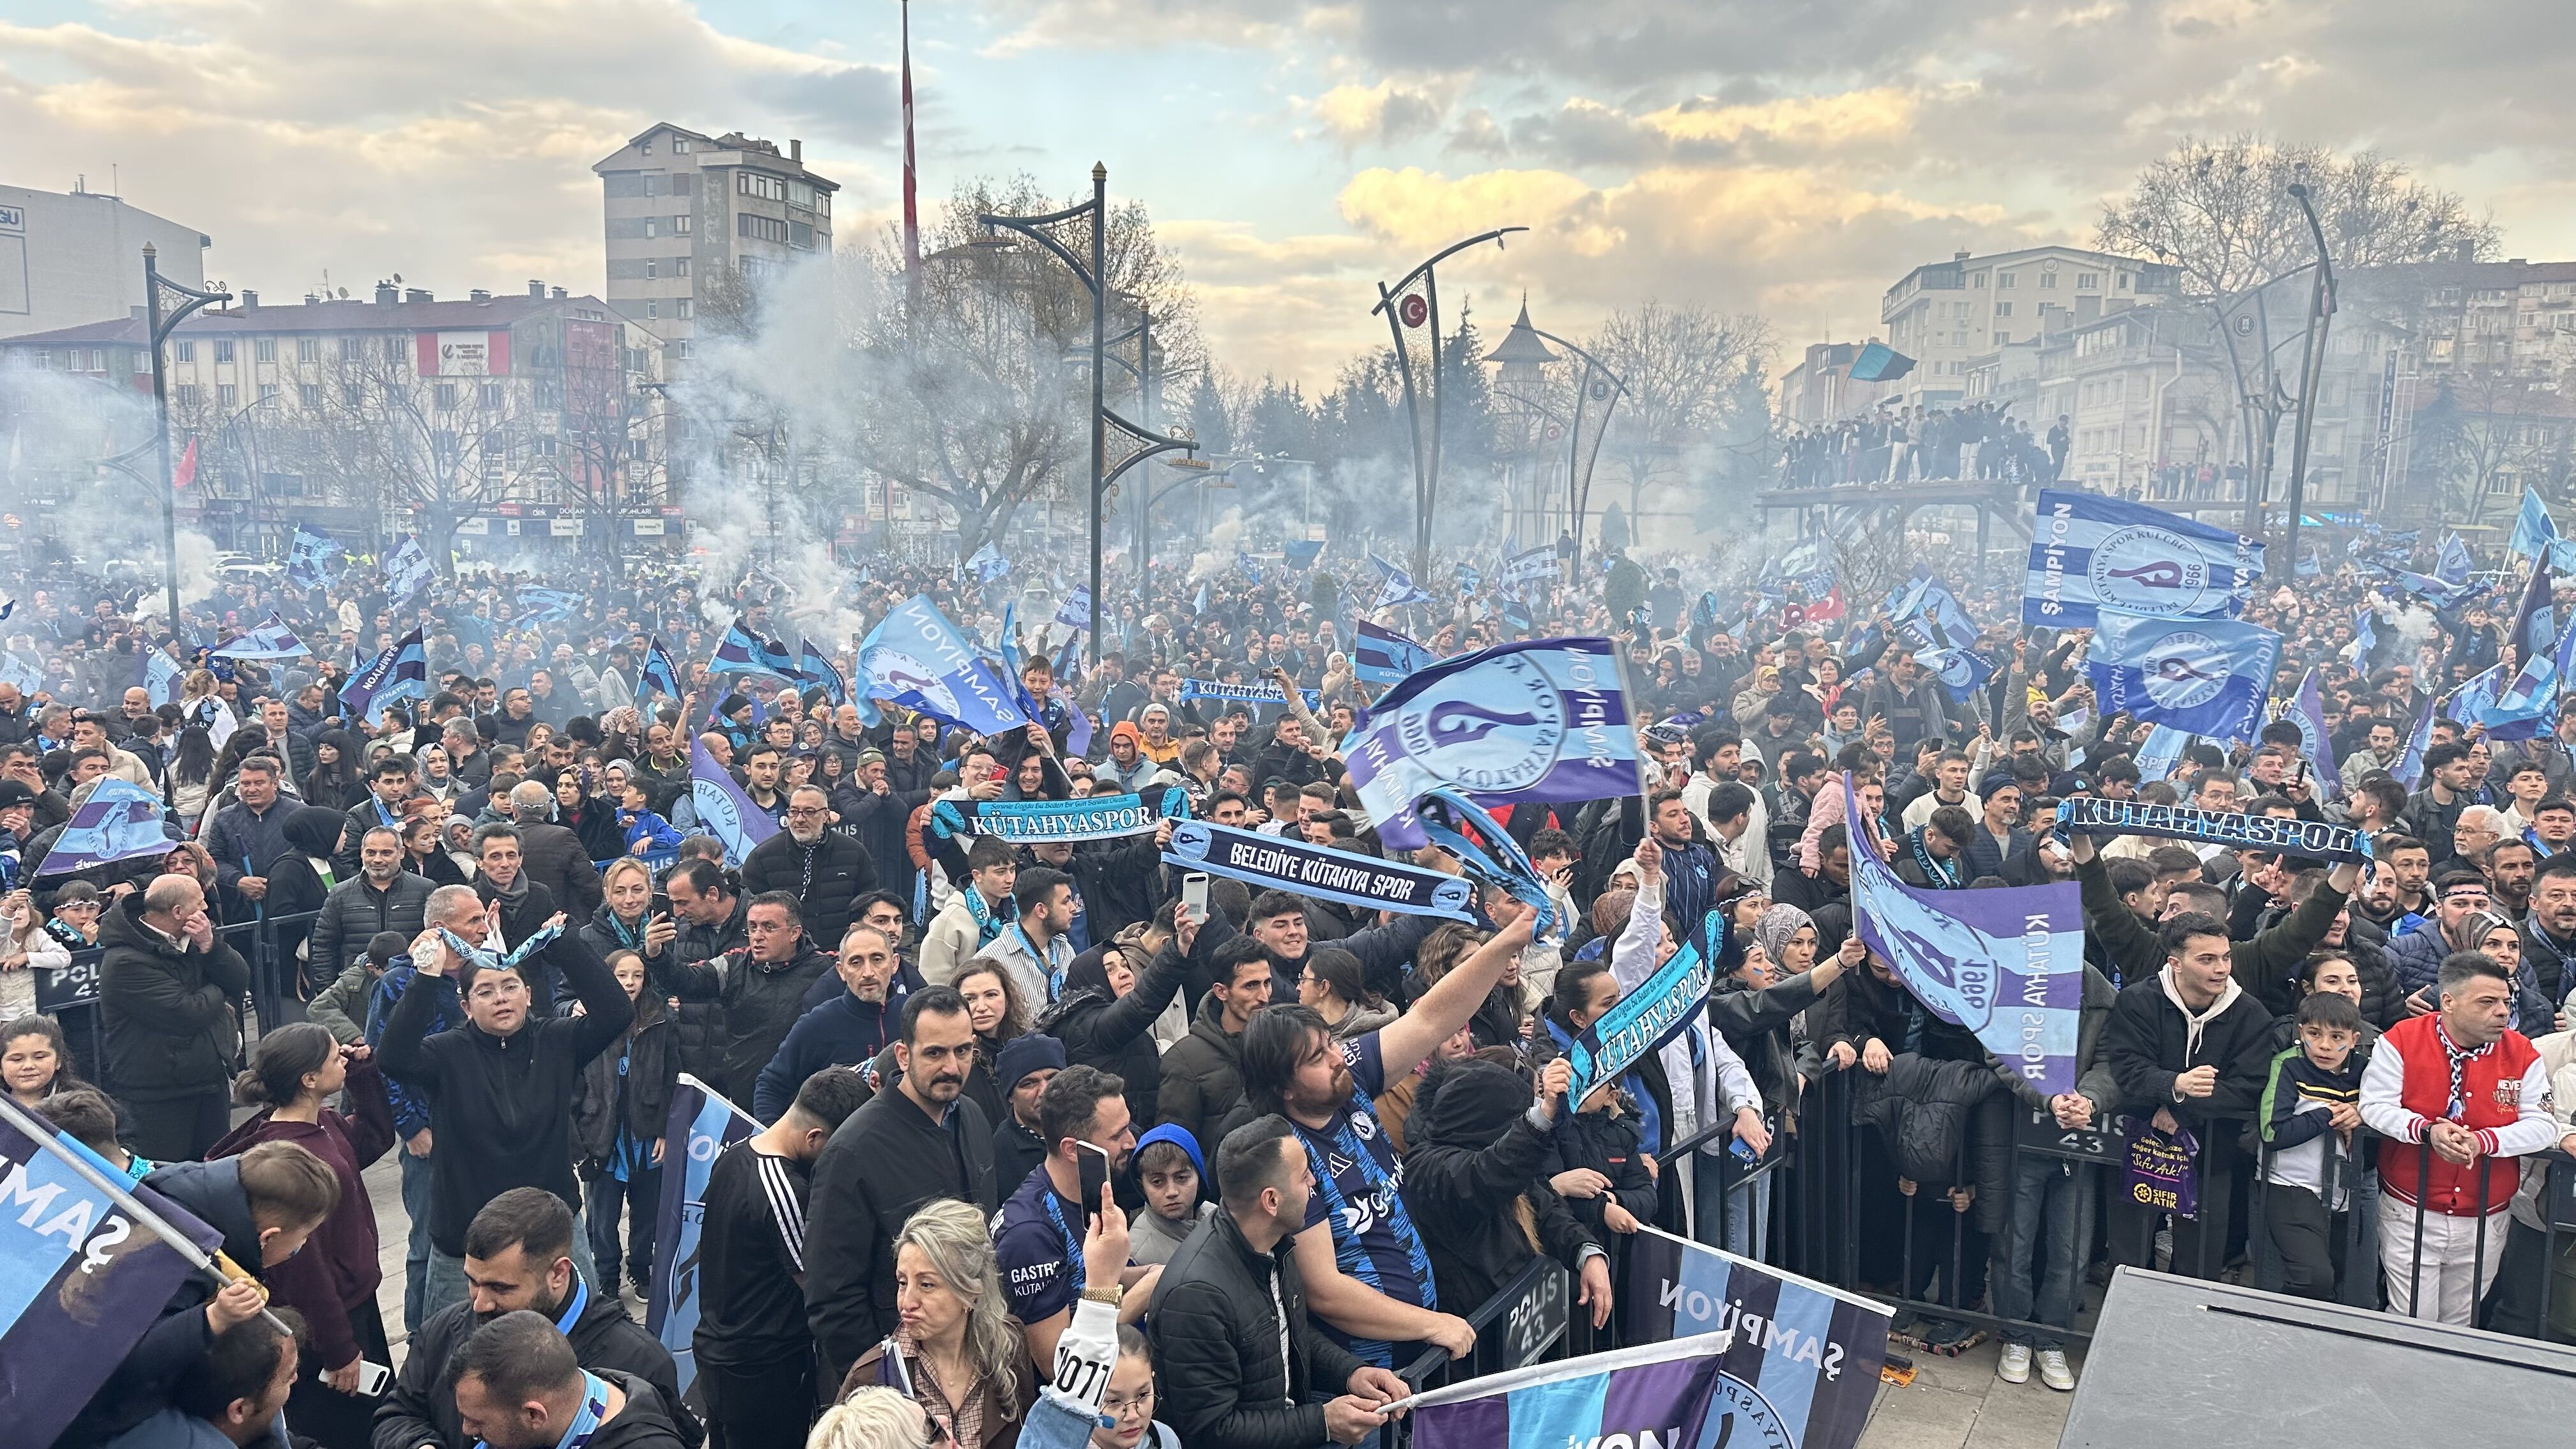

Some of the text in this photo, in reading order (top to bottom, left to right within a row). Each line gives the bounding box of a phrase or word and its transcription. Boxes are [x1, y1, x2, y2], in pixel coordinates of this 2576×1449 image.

[2105, 533, 2133, 554] SPOR
[2041, 503, 2072, 615] ŞAMPİYON
[2184, 563, 2202, 590] 1966
[1379, 670, 1406, 679] KÜTAH
[969, 806, 1152, 836] KÜTAHYASPOR
[1229, 841, 1298, 878] BELEDİYE
[1300, 857, 1371, 892] KÜTAHYA
[1371, 877, 1416, 901] SPOR
[51, 963, 100, 988] POL
[1593, 958, 1708, 1082] KÜTAHYASPOR
[2058, 1132, 2104, 1153] 43
[2131, 1142, 2152, 1154] değer
[2152, 1188, 2177, 1202] SIFIR
[2153, 1197, 2177, 1209] ATIK
[1508, 1271, 1558, 1342] POLİS
[1521, 1313, 1545, 1351] 43
